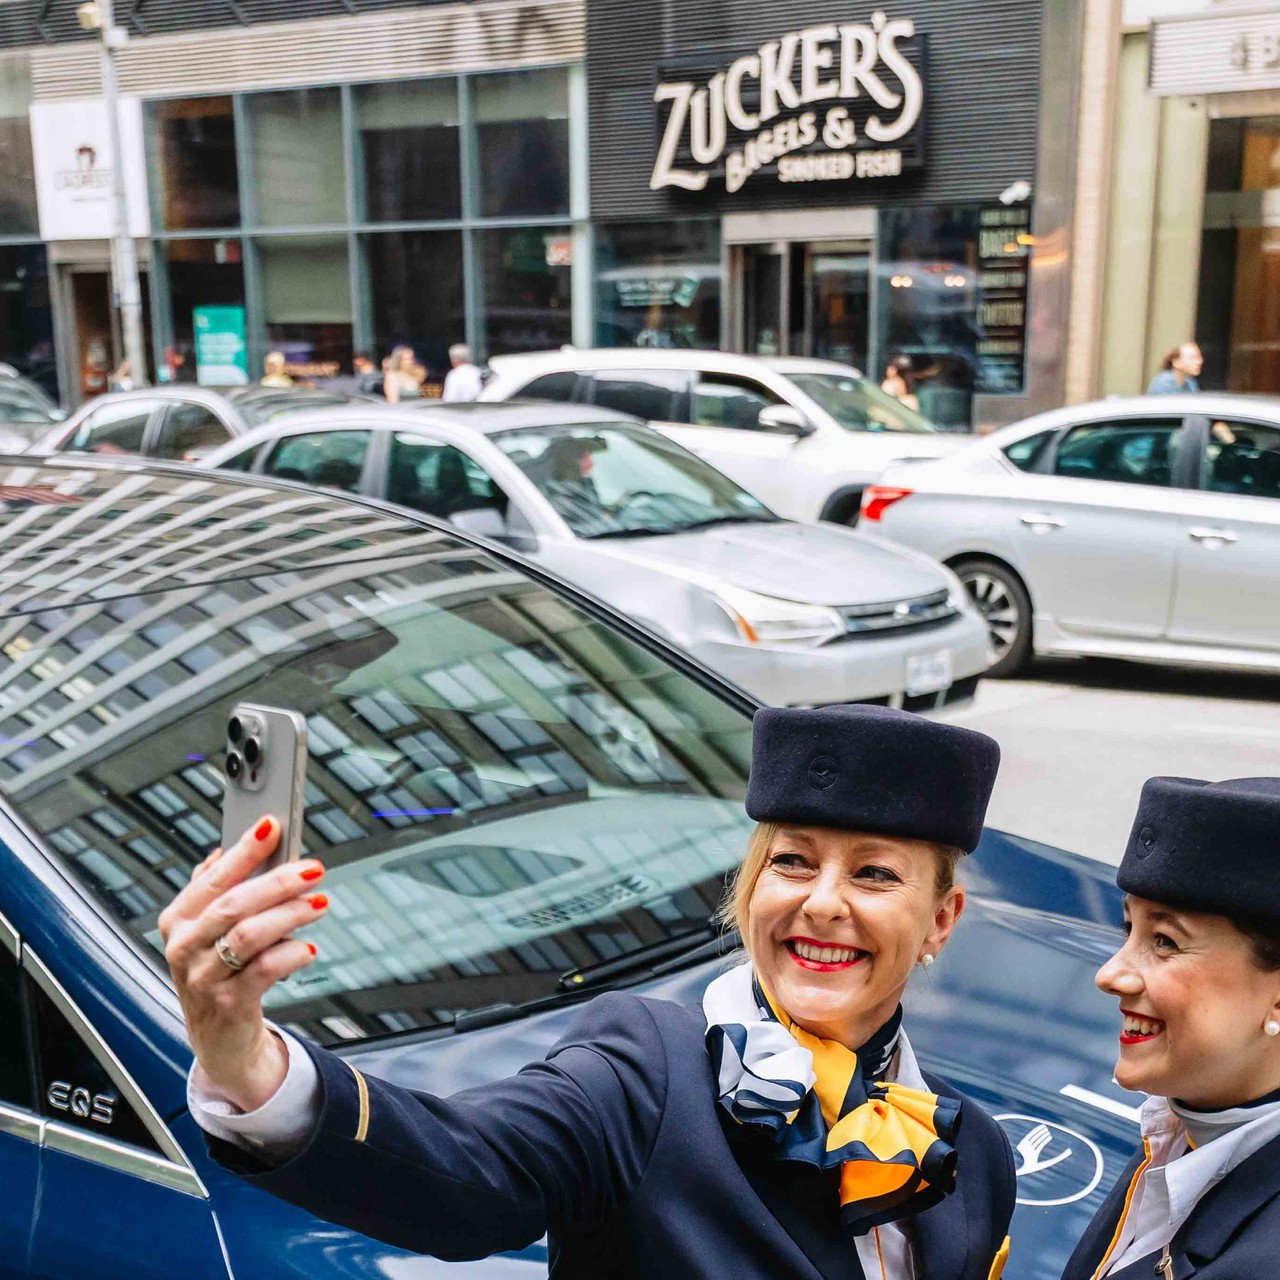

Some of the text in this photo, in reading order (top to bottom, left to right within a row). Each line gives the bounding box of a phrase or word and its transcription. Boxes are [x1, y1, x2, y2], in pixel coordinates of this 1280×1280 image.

[649, 10, 923, 191] ZUCKER'S
[725, 106, 857, 193] BAGELS &
[855, 149, 903, 178] FISH
[47, 1080, 116, 1125] EQS
